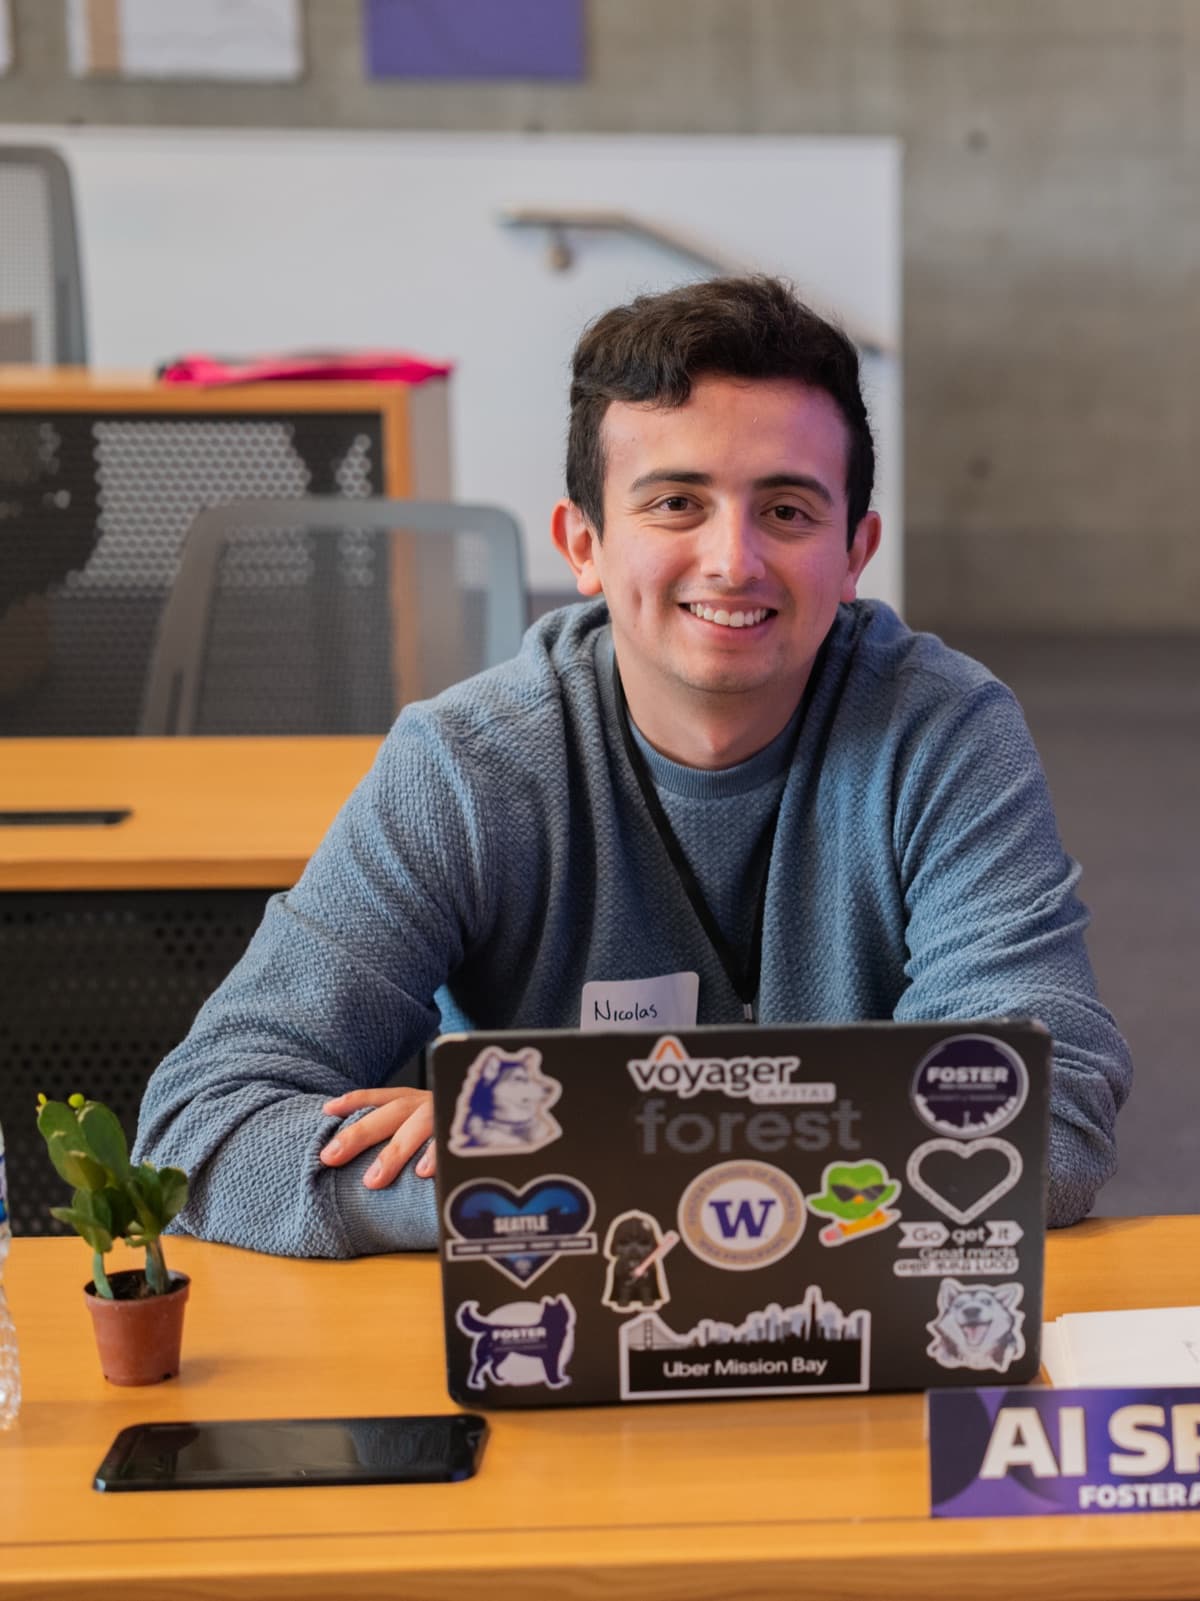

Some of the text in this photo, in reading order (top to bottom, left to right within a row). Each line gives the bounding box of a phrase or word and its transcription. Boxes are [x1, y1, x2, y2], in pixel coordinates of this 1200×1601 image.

[594, 999, 658, 1022] Nicolas
[926, 1066, 1009, 1083] FOSTER
[634, 1099, 862, 1154] forest
[493, 1213, 549, 1234] SEATTLE
[708, 1198, 777, 1239] W
[912, 1226, 942, 1242] Go
[491, 1327, 547, 1341] FOSTER
[662, 1355, 828, 1378] Uber Mission Bay
[979, 1406, 1088, 1480] AI
[1078, 1482, 1187, 1509] FOSTER
